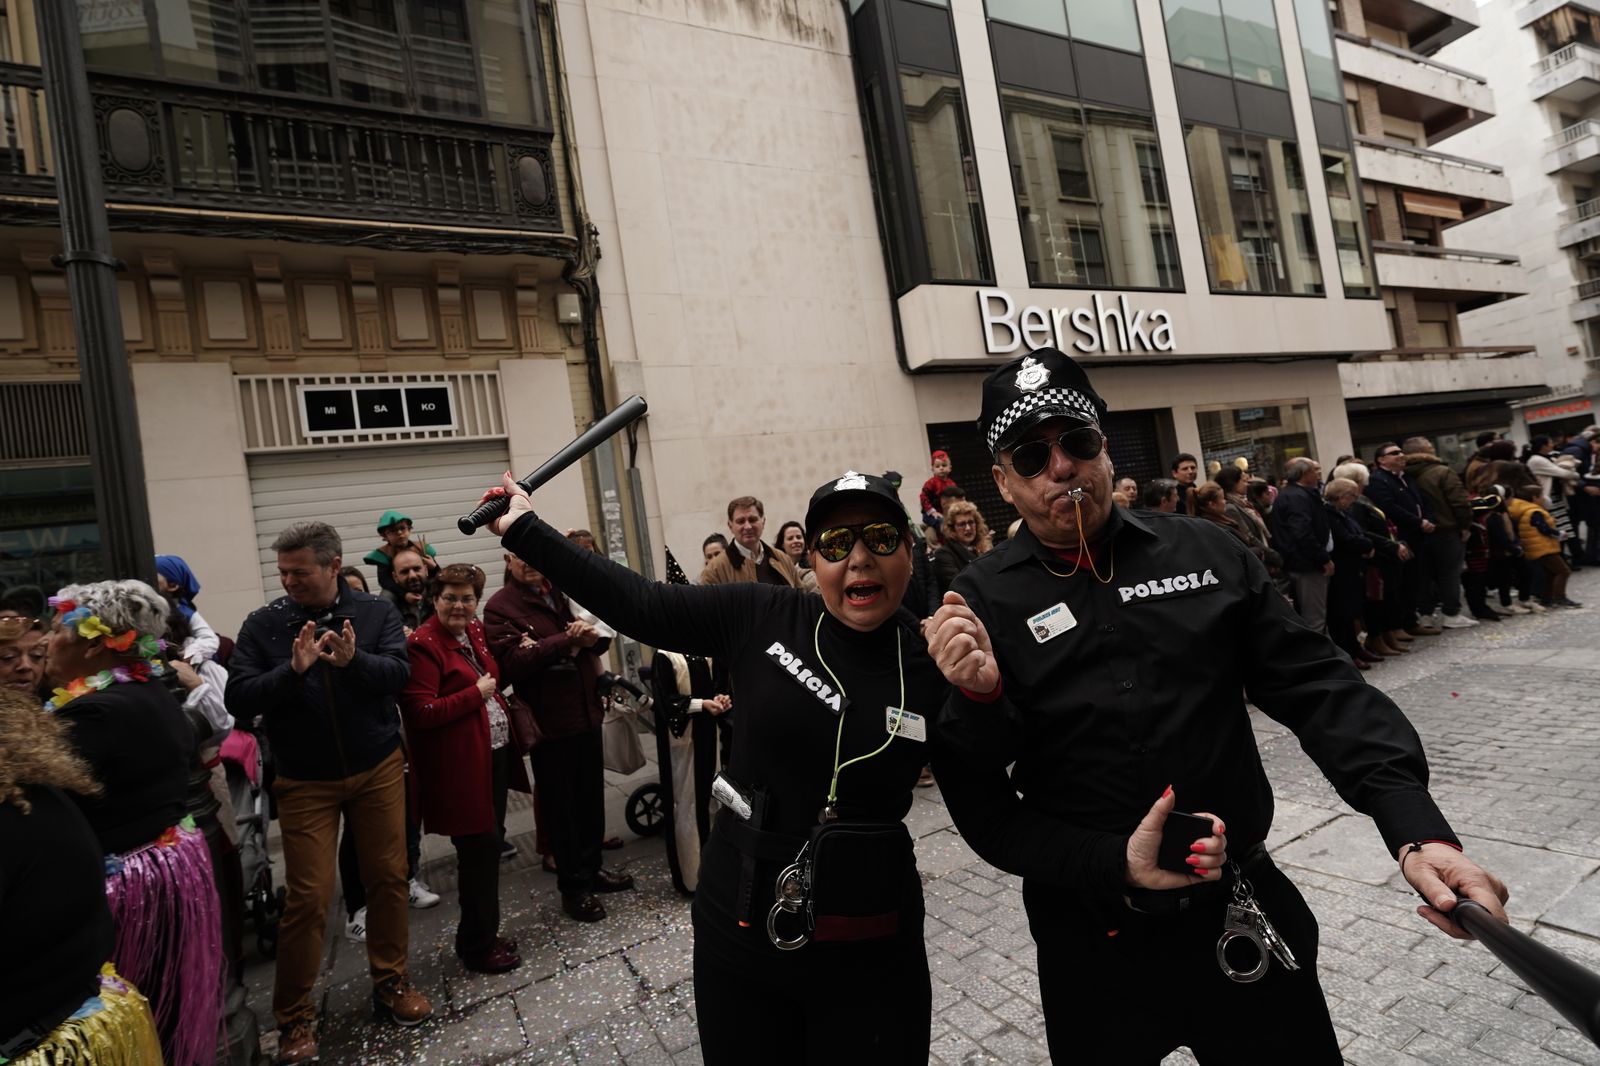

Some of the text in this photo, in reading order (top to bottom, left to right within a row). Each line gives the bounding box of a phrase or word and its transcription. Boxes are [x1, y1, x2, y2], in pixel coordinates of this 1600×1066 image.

[977, 288, 1177, 353] Bershka
[325, 402, 436, 414] MI SA KO
[1118, 569, 1219, 603] POLICIA
[765, 641, 841, 712] POLICIA
